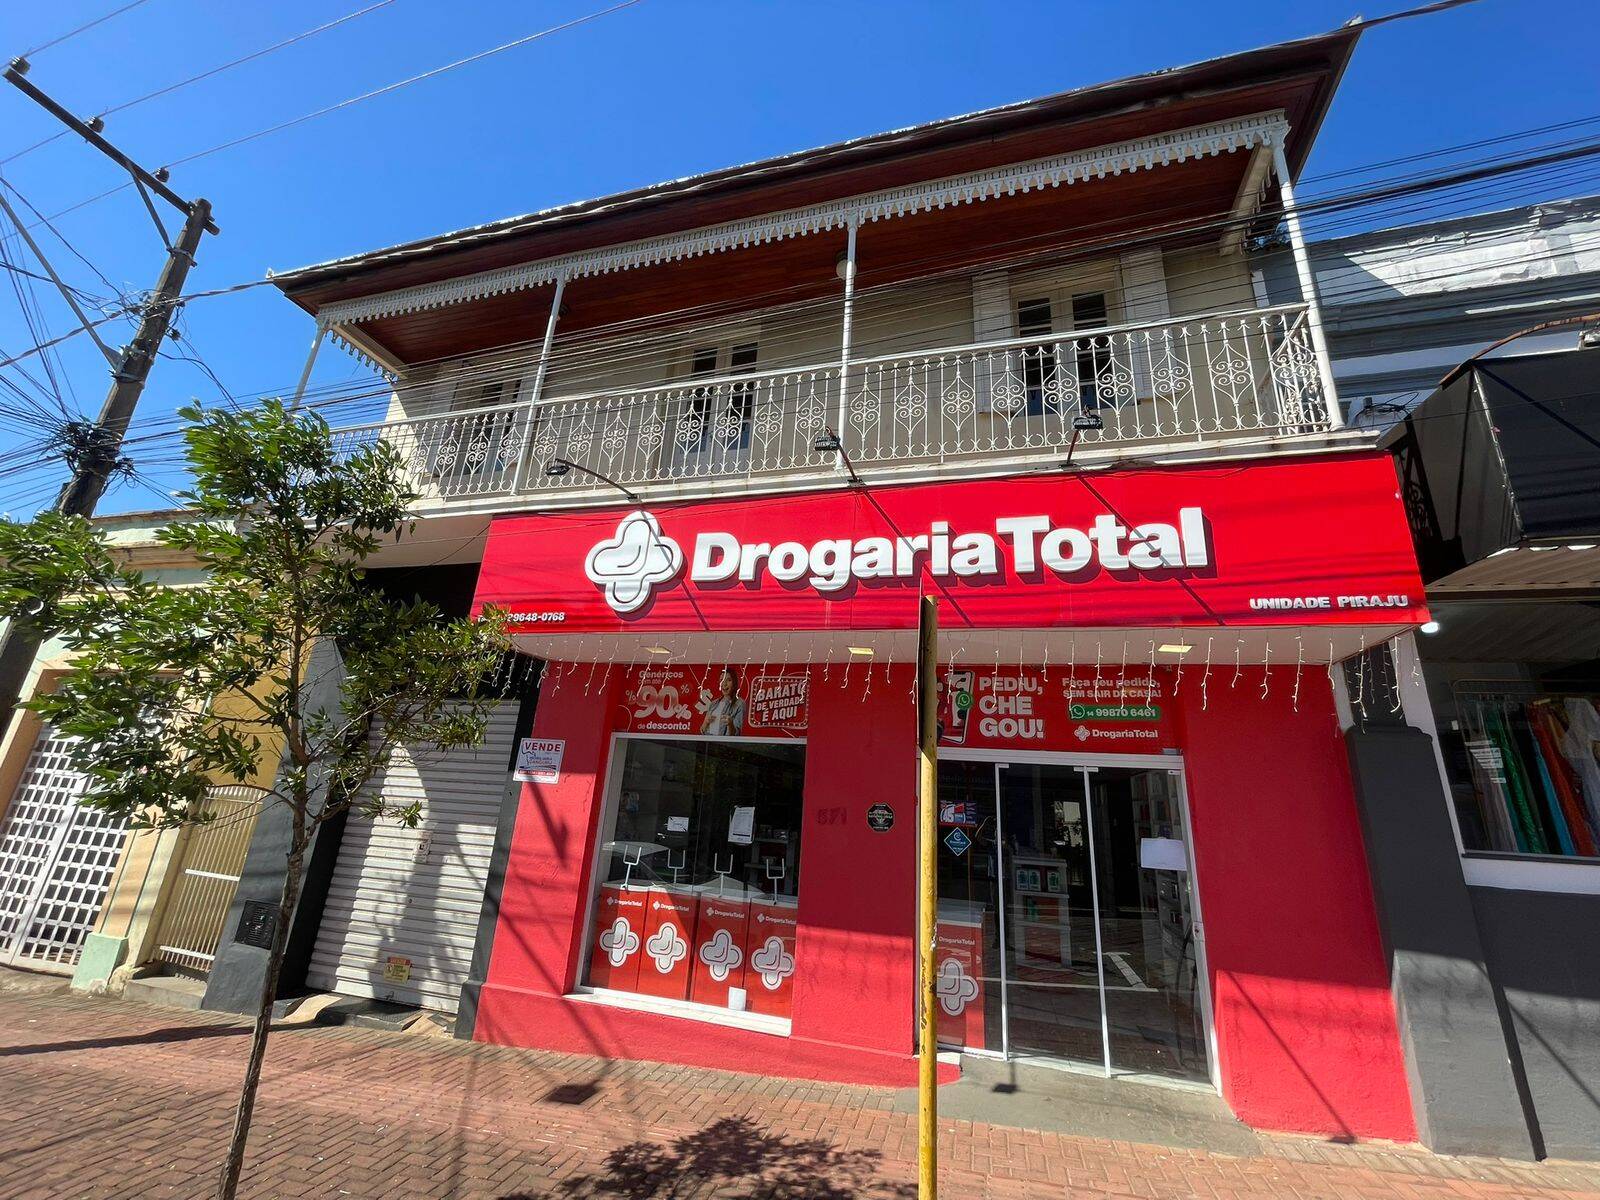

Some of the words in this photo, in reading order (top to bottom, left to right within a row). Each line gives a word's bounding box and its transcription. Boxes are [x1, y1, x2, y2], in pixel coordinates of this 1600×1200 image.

[1250, 597, 1331, 610] UNIDADE
[1337, 595, 1409, 608] PIRAJU
[979, 676, 1043, 695] PEDIU,
[1062, 677, 1090, 689] Faça
[1063, 689, 1085, 698] SEM
[1087, 689, 1111, 698] SAIR
[1129, 689, 1162, 698] CASA!
[634, 685, 692, 719] 90%
[756, 701, 767, 711] DE
[979, 696, 1032, 715] CHE
[772, 706, 797, 720] AQUI
[1096, 708, 1128, 717] 99870
[646, 721, 691, 730] desconto!
[979, 718, 1044, 739] GOU!
[525, 742, 561, 752] VENDE
